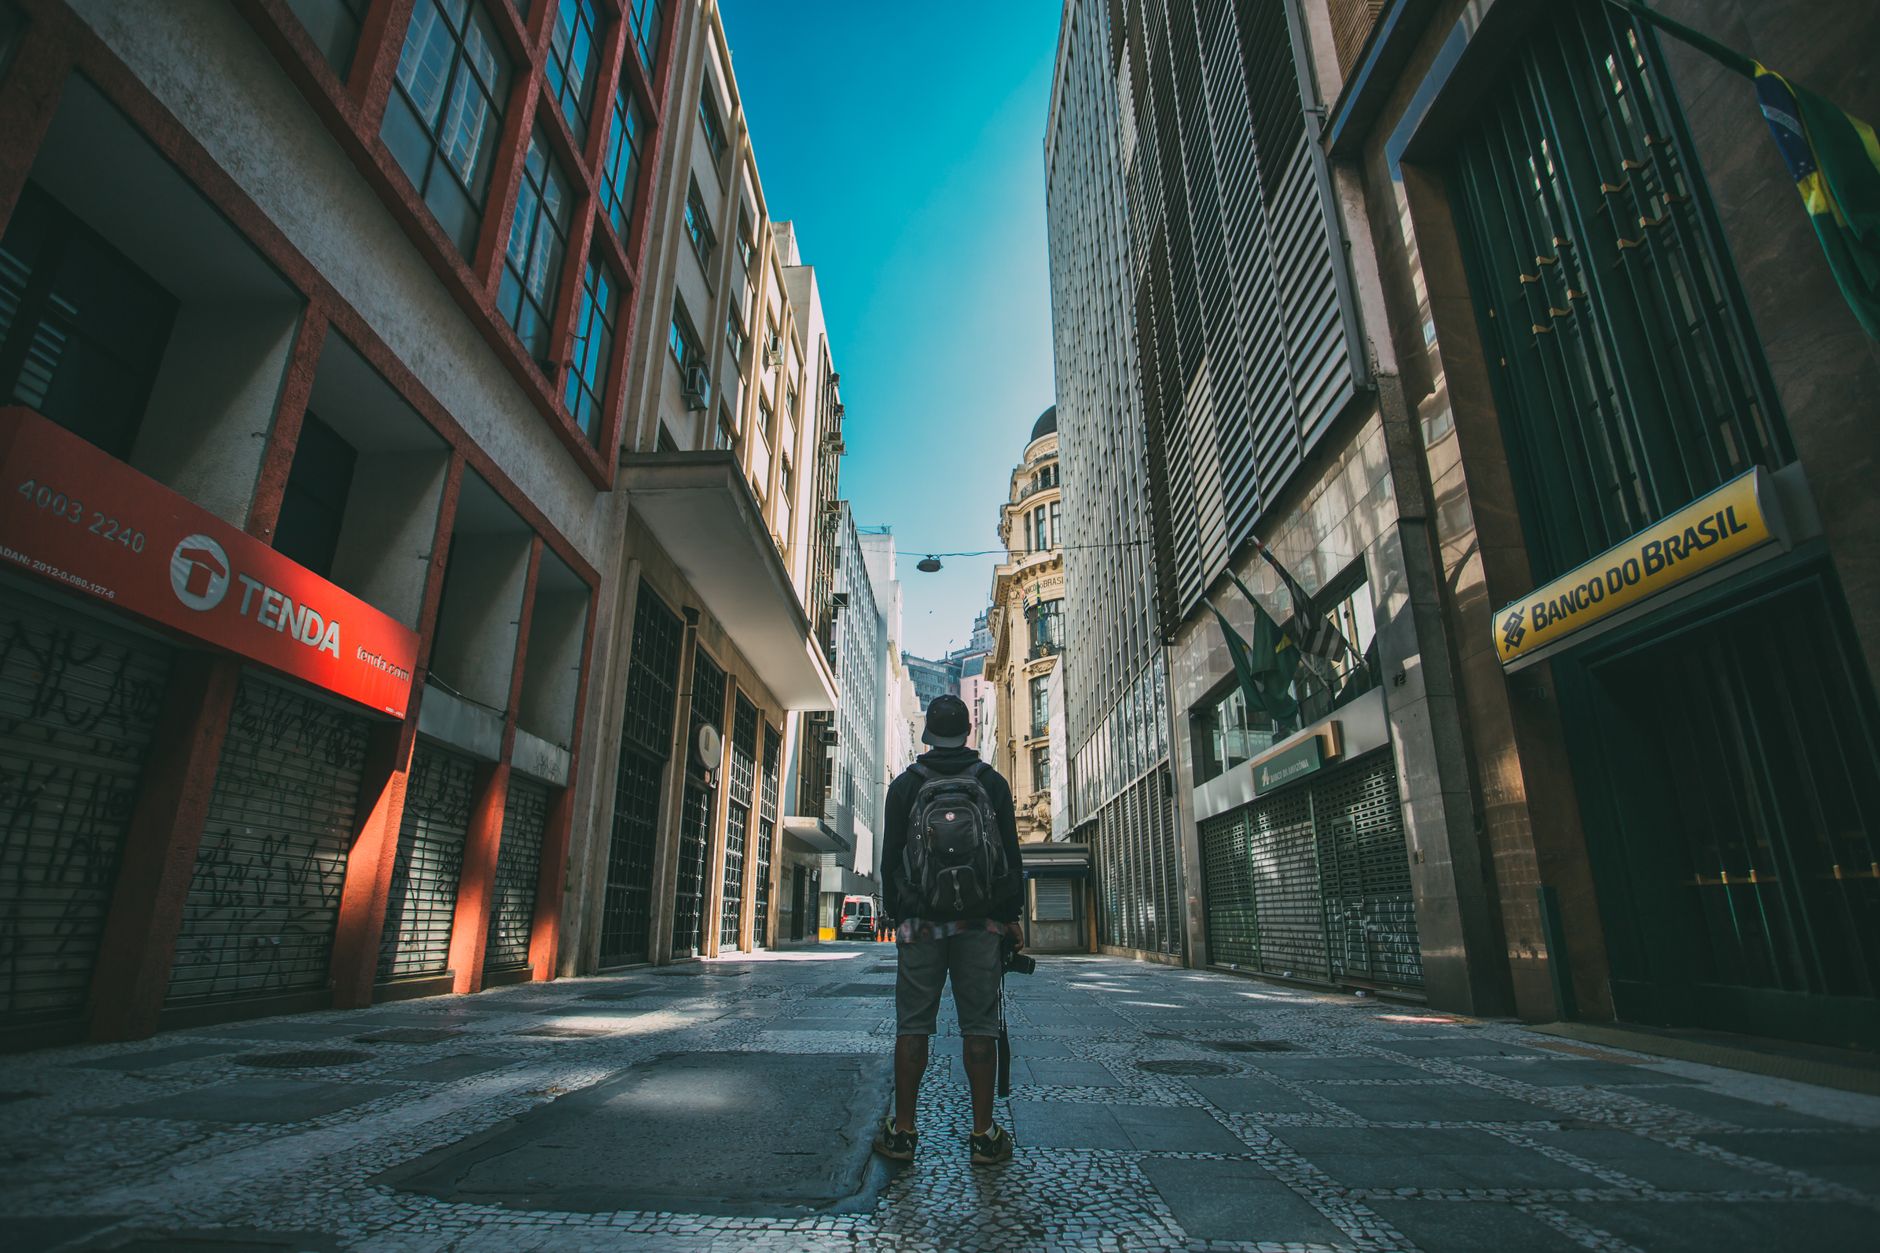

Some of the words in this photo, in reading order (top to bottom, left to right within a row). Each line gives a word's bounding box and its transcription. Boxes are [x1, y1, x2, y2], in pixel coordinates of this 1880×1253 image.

[18, 479, 83, 523] 4003
[88, 511, 146, 553] 2240
[1043, 576, 1064, 588] BRASI
[1531, 576, 1605, 632] BANCO
[1605, 558, 1641, 595] DO
[1641, 505, 1748, 576] BRASIL
[238, 573, 340, 660] TENDA
[356, 644, 410, 682] tenda.com
